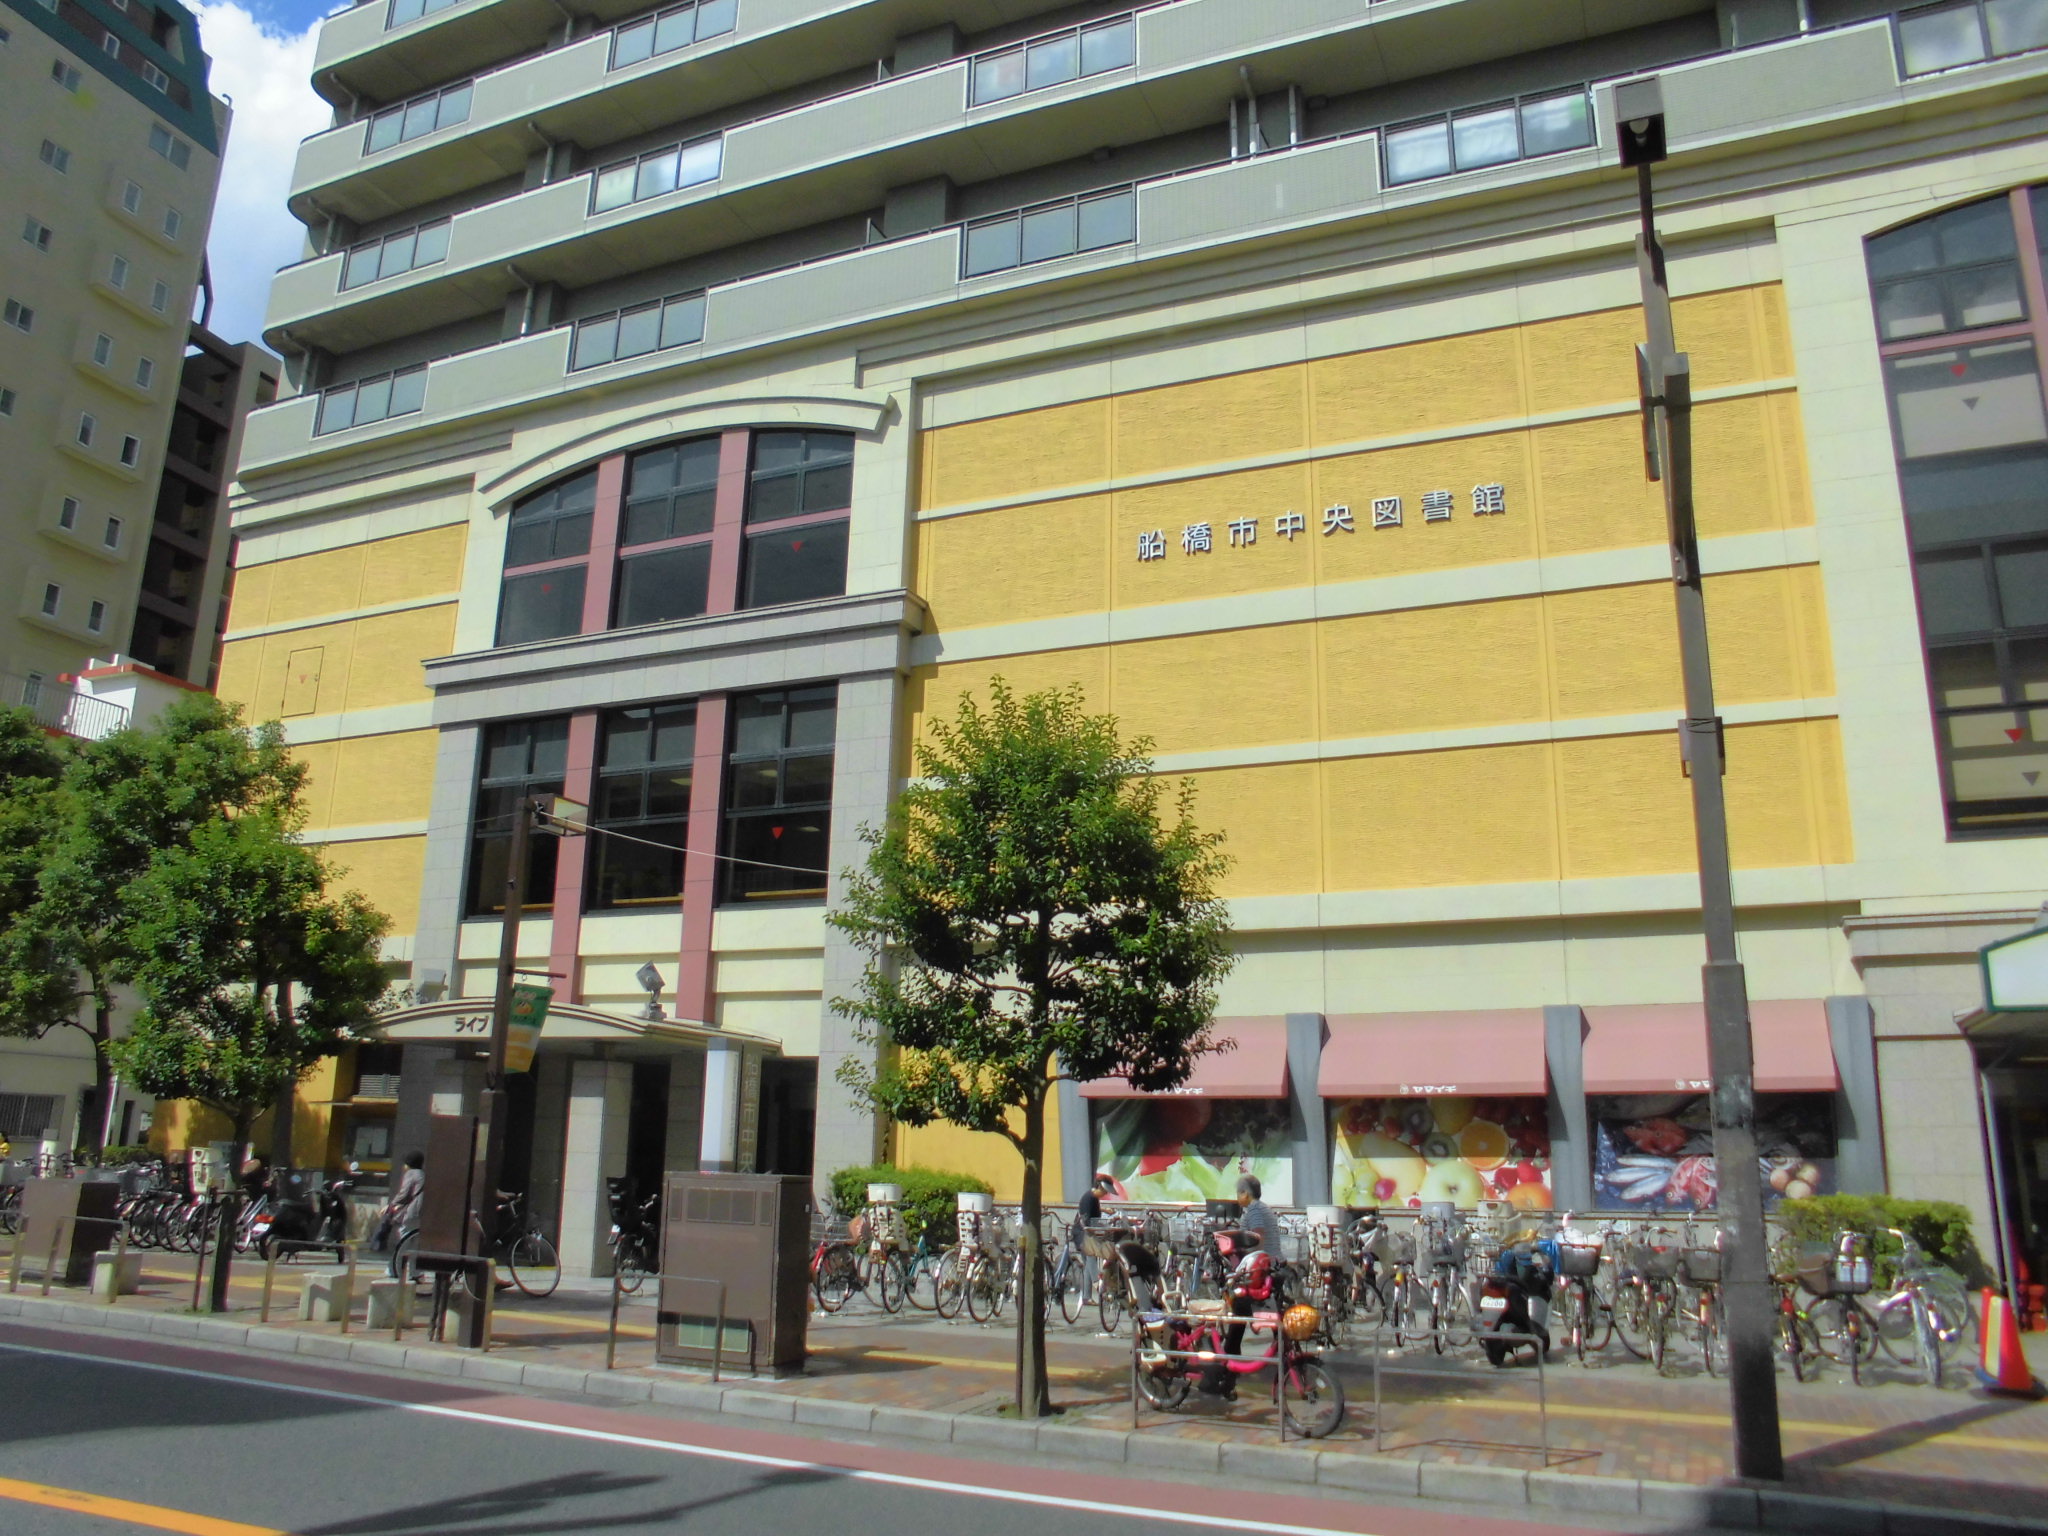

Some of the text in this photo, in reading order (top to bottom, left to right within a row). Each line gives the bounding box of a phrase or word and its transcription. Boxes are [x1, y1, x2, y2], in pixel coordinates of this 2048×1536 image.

[1137, 482, 1505, 561] 船橋市中央図書館
